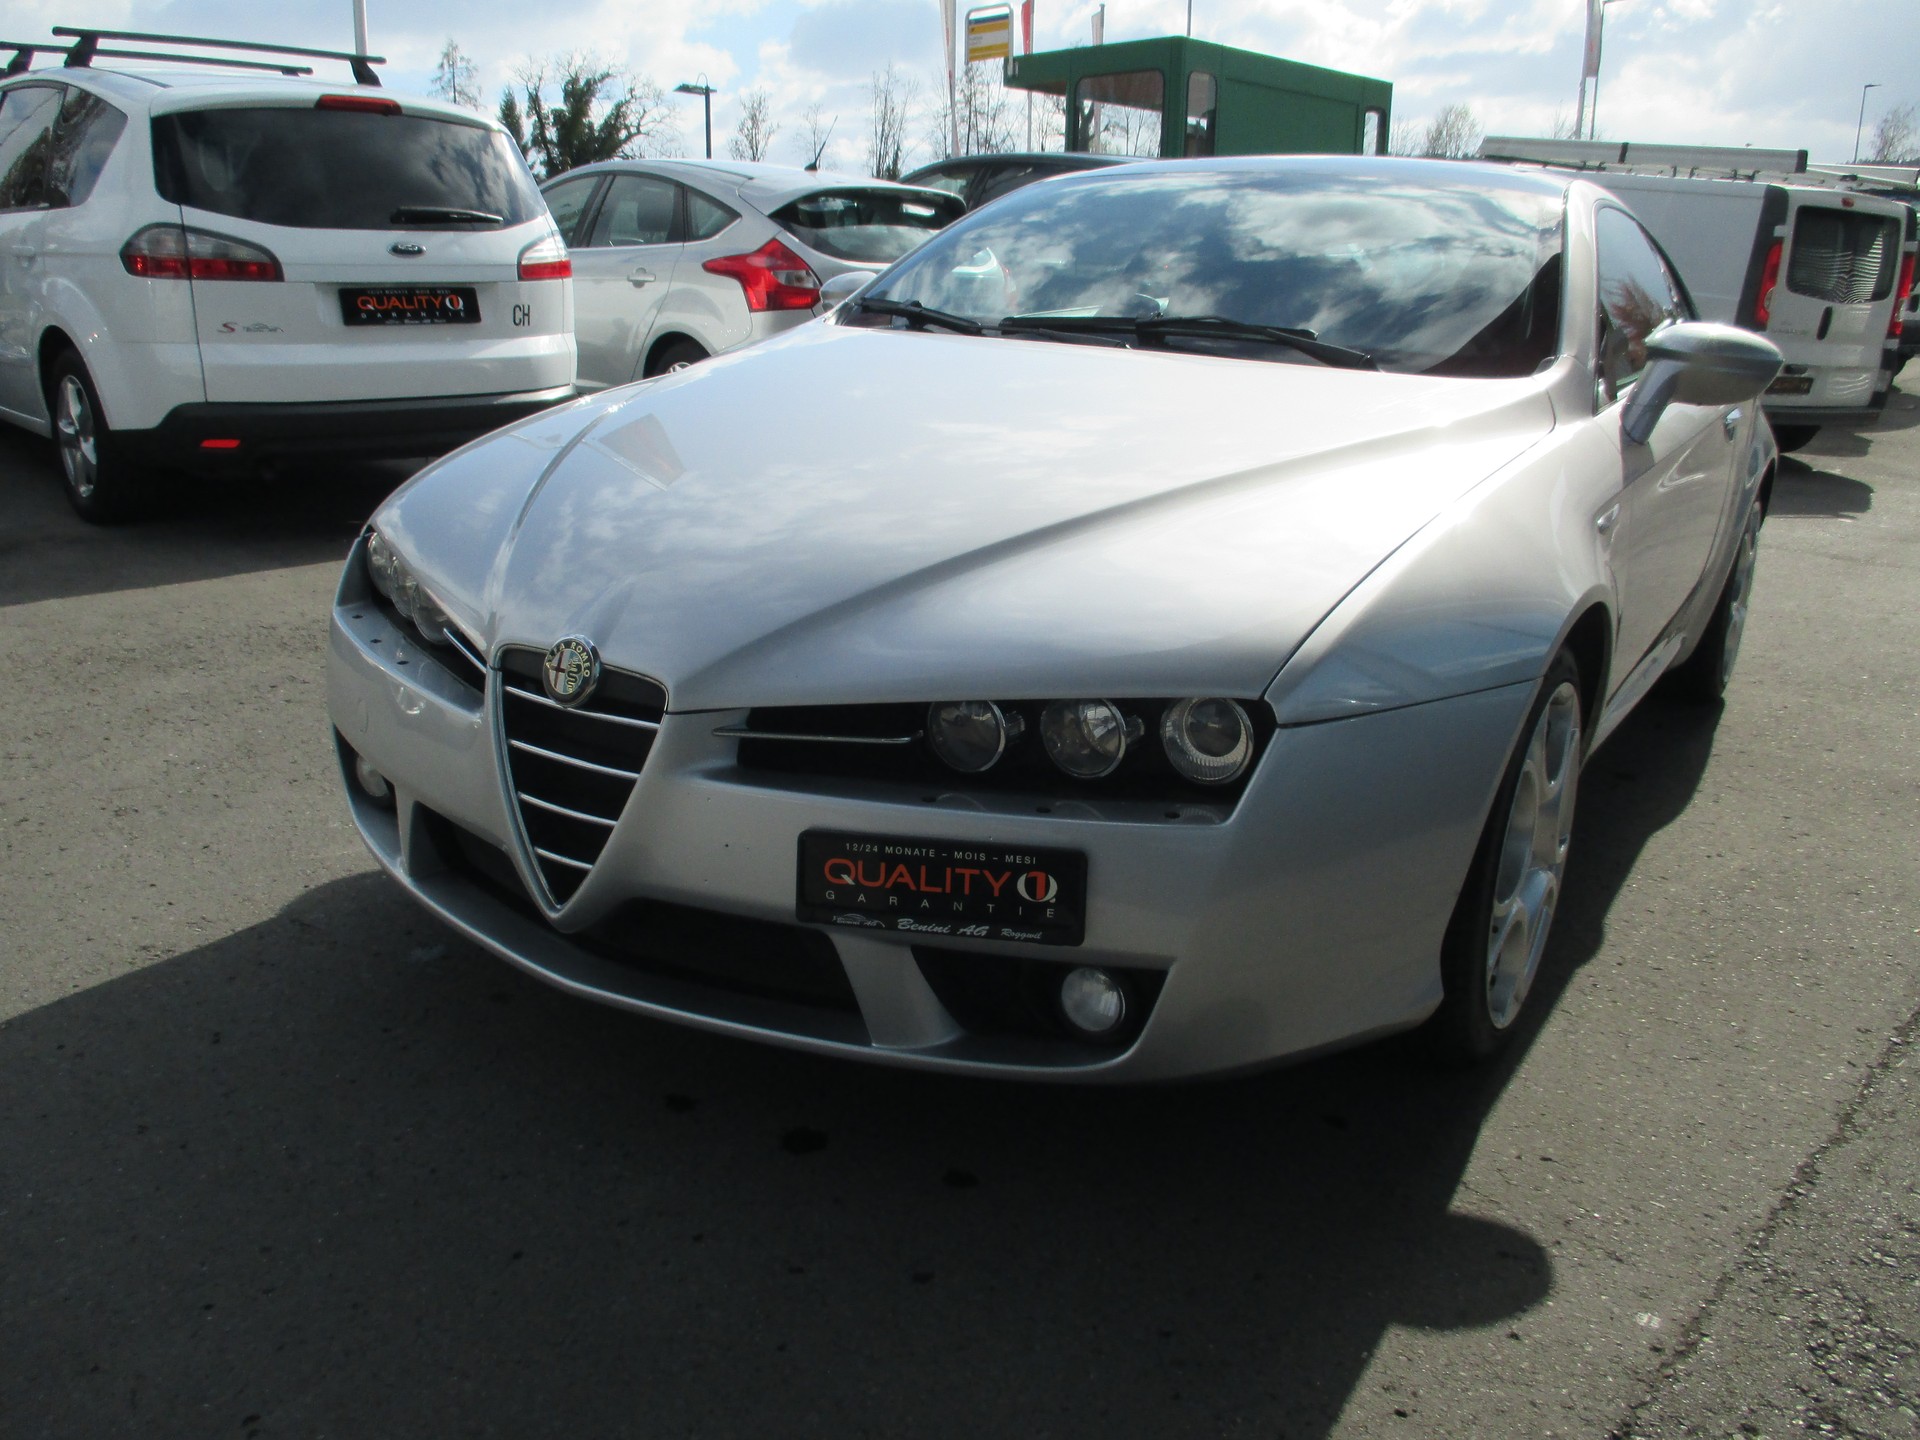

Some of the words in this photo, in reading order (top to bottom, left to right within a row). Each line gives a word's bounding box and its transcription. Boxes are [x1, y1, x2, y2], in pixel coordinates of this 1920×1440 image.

[356, 294, 443, 311] QUALITY
[512, 303, 531, 327] CH
[570, 641, 591, 678] ROMEO
[845, 842, 879, 854] 12/24
[884, 845, 936, 858] MONATE
[953, 851, 987, 861] MOIS
[1004, 854, 1037, 865] MESI
[823, 857, 1013, 898] QUALITY
[824, 889, 1056, 919] GARANTIE
[896, 917, 952, 935] Benini
[956, 924, 991, 937] AG
[1000, 927, 1043, 940] Roggwil
